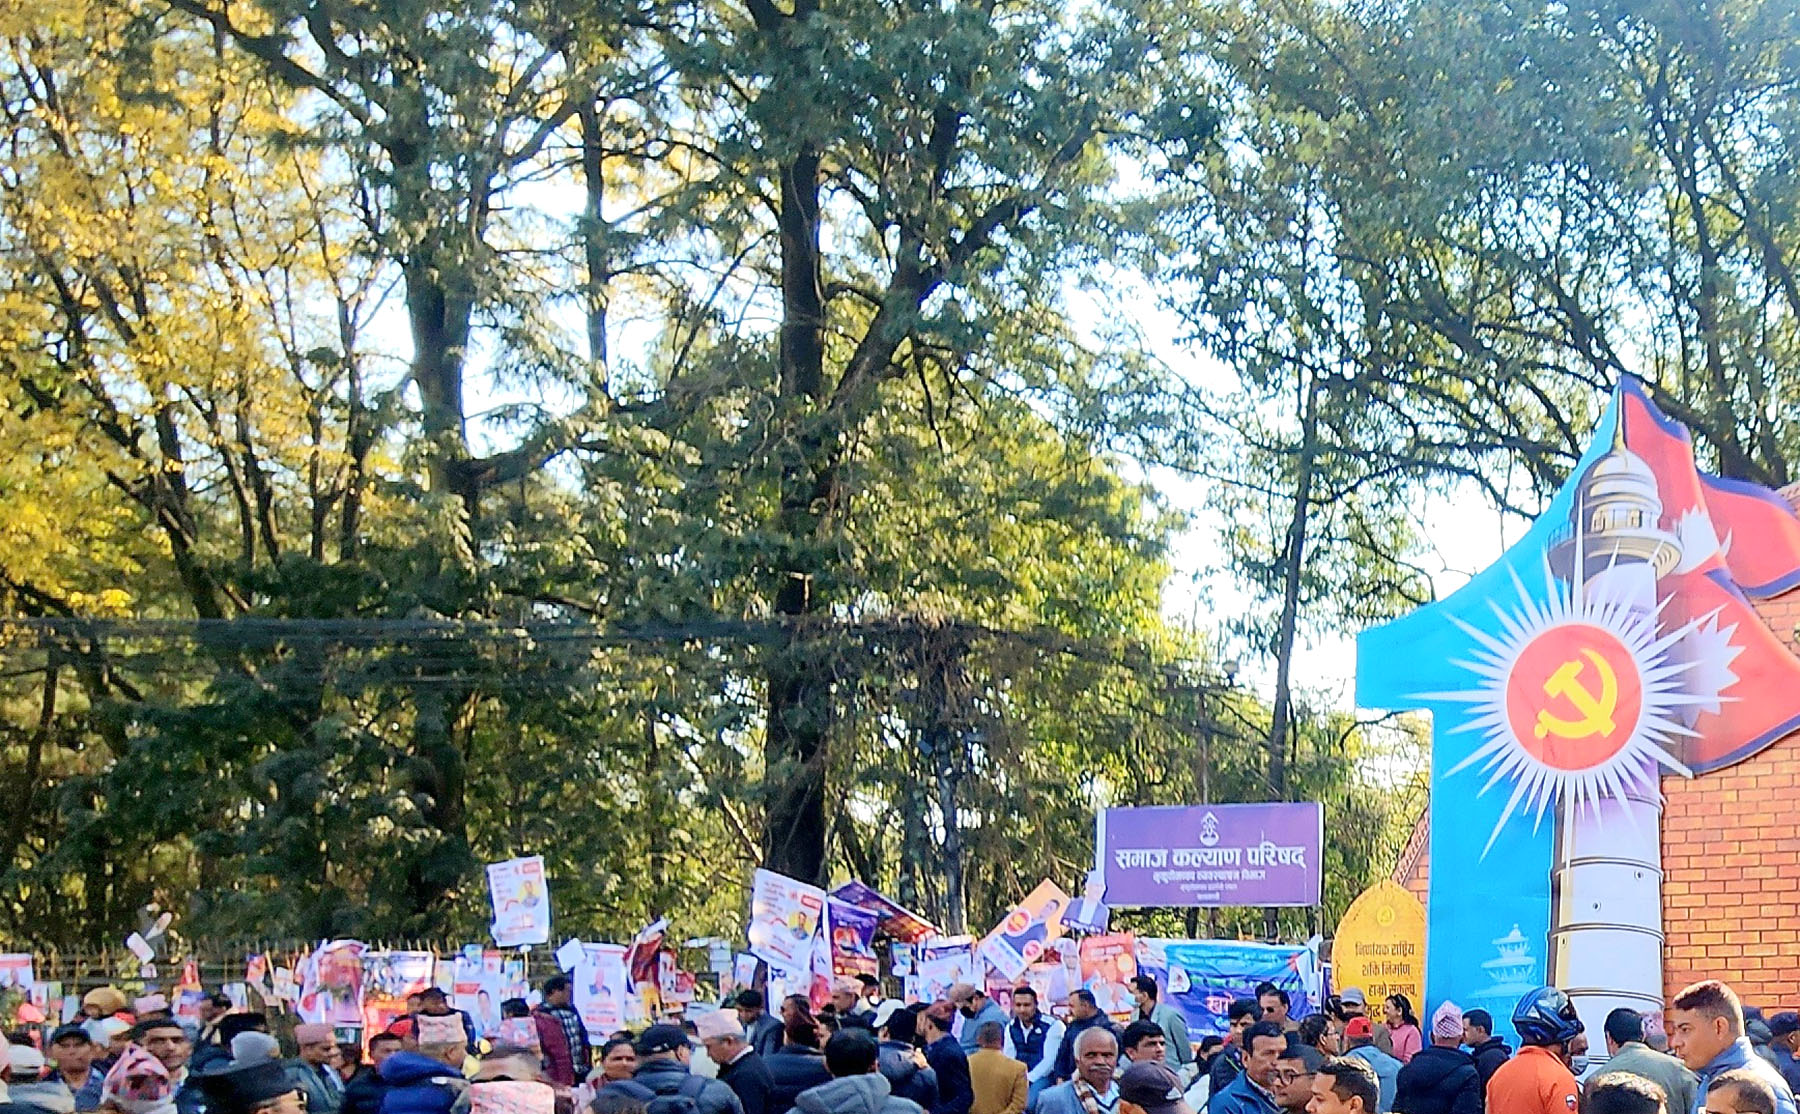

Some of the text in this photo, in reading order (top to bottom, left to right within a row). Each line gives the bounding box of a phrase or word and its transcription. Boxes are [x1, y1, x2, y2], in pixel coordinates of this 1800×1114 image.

[1114, 841, 1306, 869] समाज कल्याण परिषद्
[1381, 960, 1411, 977] निर्माण
[1368, 981, 1387, 997] हाम्रो
